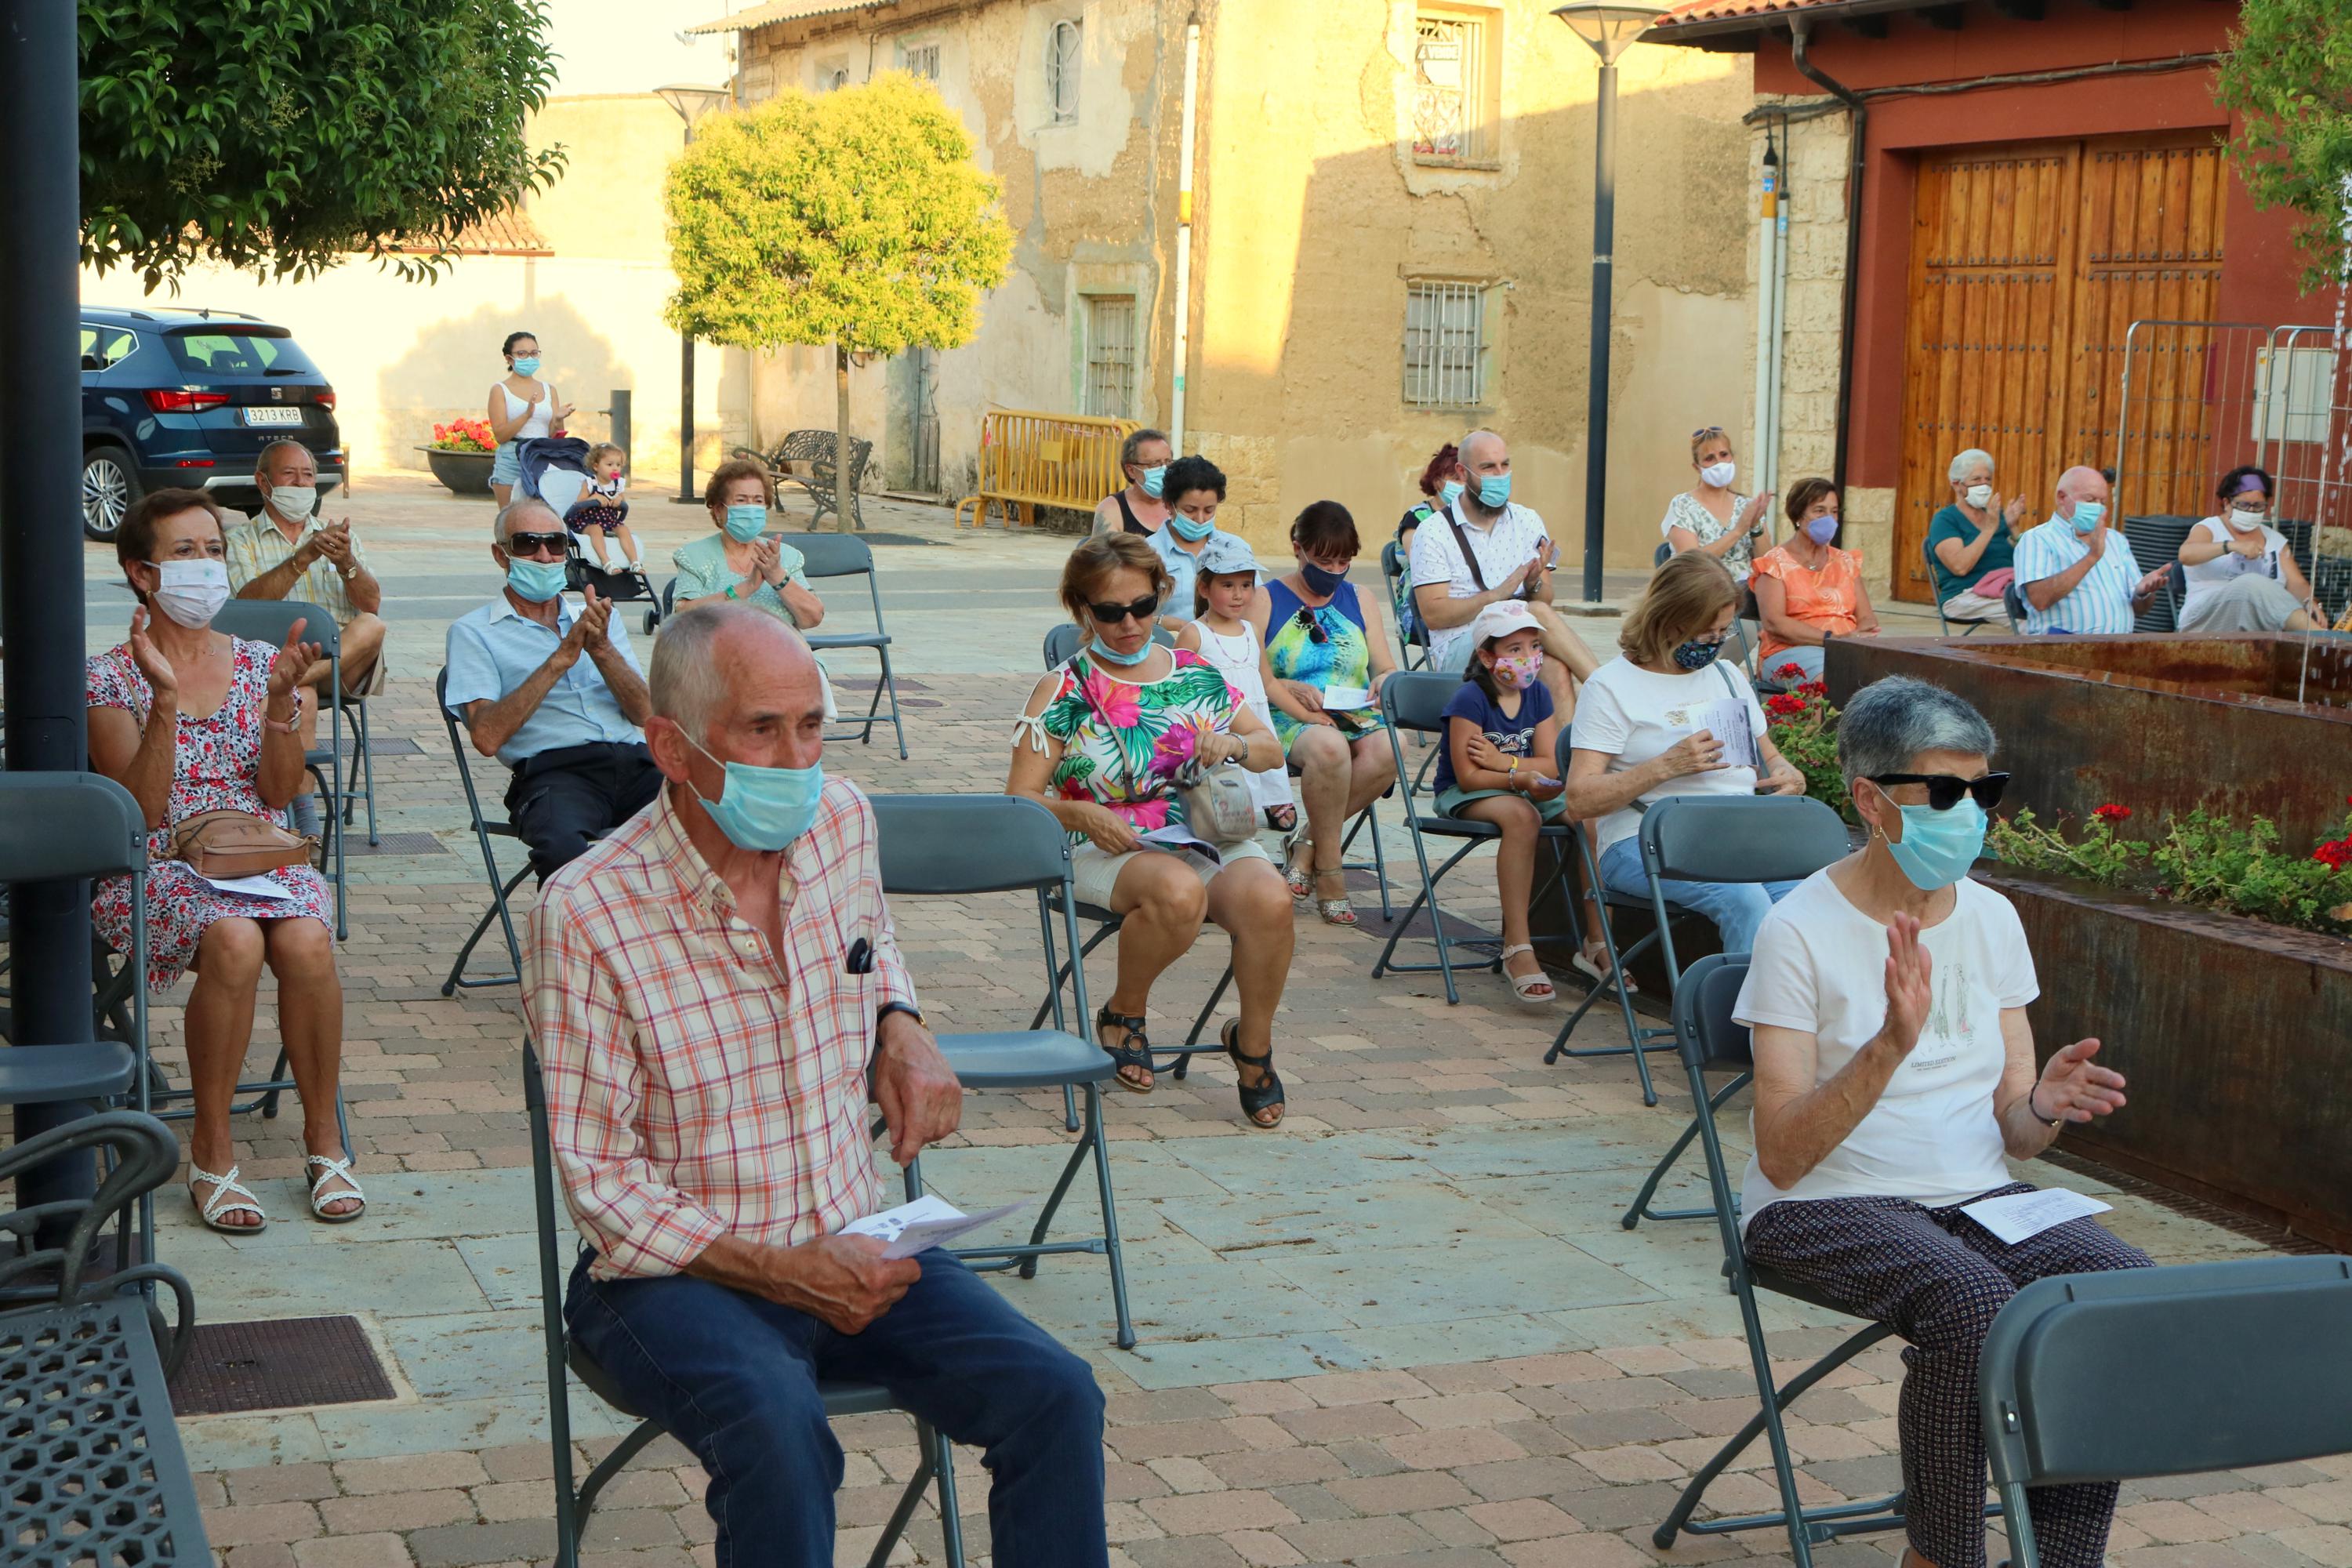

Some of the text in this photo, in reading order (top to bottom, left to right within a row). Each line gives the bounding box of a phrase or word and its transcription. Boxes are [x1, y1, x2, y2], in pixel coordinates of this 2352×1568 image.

[1428, 45, 1458, 59] VENDE
[251, 409, 299, 420] 3213 KRB
[1934, 1055, 1957, 1065] EDITION
